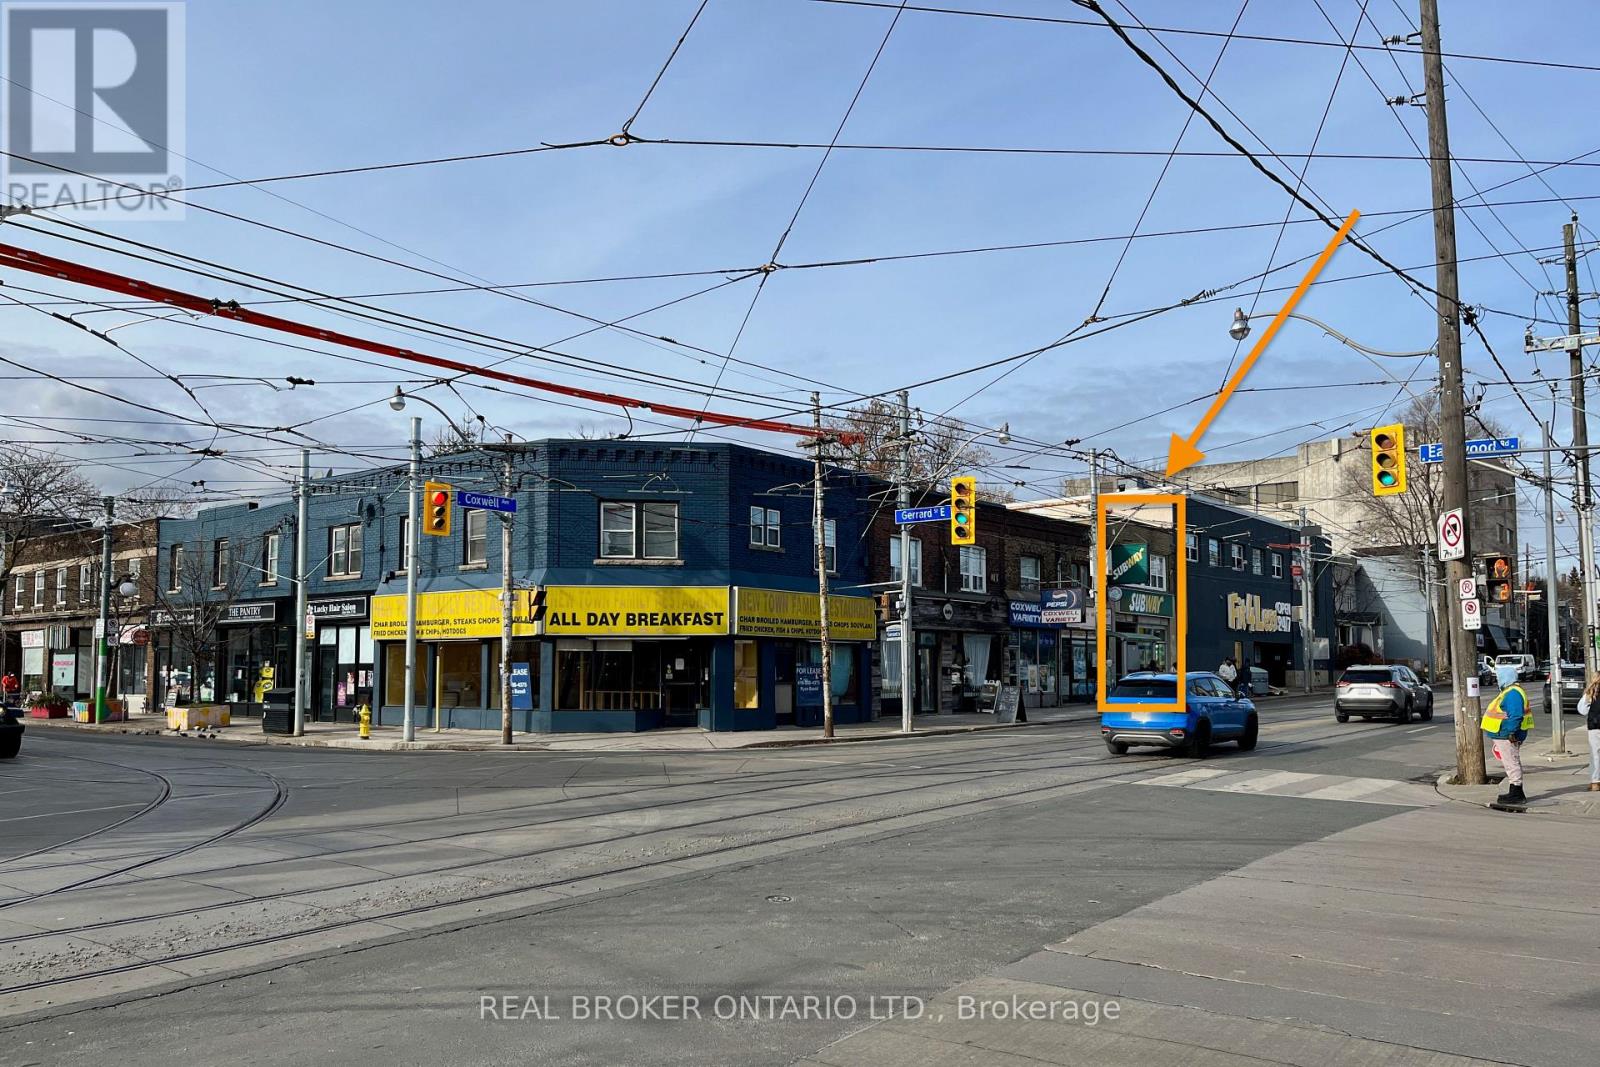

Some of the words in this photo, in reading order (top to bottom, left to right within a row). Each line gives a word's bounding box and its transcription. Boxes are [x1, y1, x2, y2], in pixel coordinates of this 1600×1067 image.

[1429, 440, 1496, 458] Eaood
[1500, 439, 1510, 447] Rd
[465, 493, 500, 509] Coxwell
[901, 508, 933, 520] Gerrard
[940, 507, 946, 517] E
[1112, 546, 1145, 580] SUBWAY
[313, 605, 328, 614] Lucky
[329, 603, 340, 612] Hair
[341, 602, 356, 612] Salon
[1129, 592, 1164, 614] SUBWAY
[1275, 601, 1291, 615] OPEN
[229, 608, 239, 617] THE
[240, 605, 261, 617] PANTRY
[453, 618, 477, 626] STEAKS
[549, 612, 581, 626] ALL
[586, 612, 620, 626] DAY
[625, 612, 724, 627] BREAKFAST
[739, 615, 755, 623] CHAR
[756, 616, 780, 625] BROILED
[833, 621, 849, 629] CHOPS
[442, 627, 467, 635] HOTDOGS
